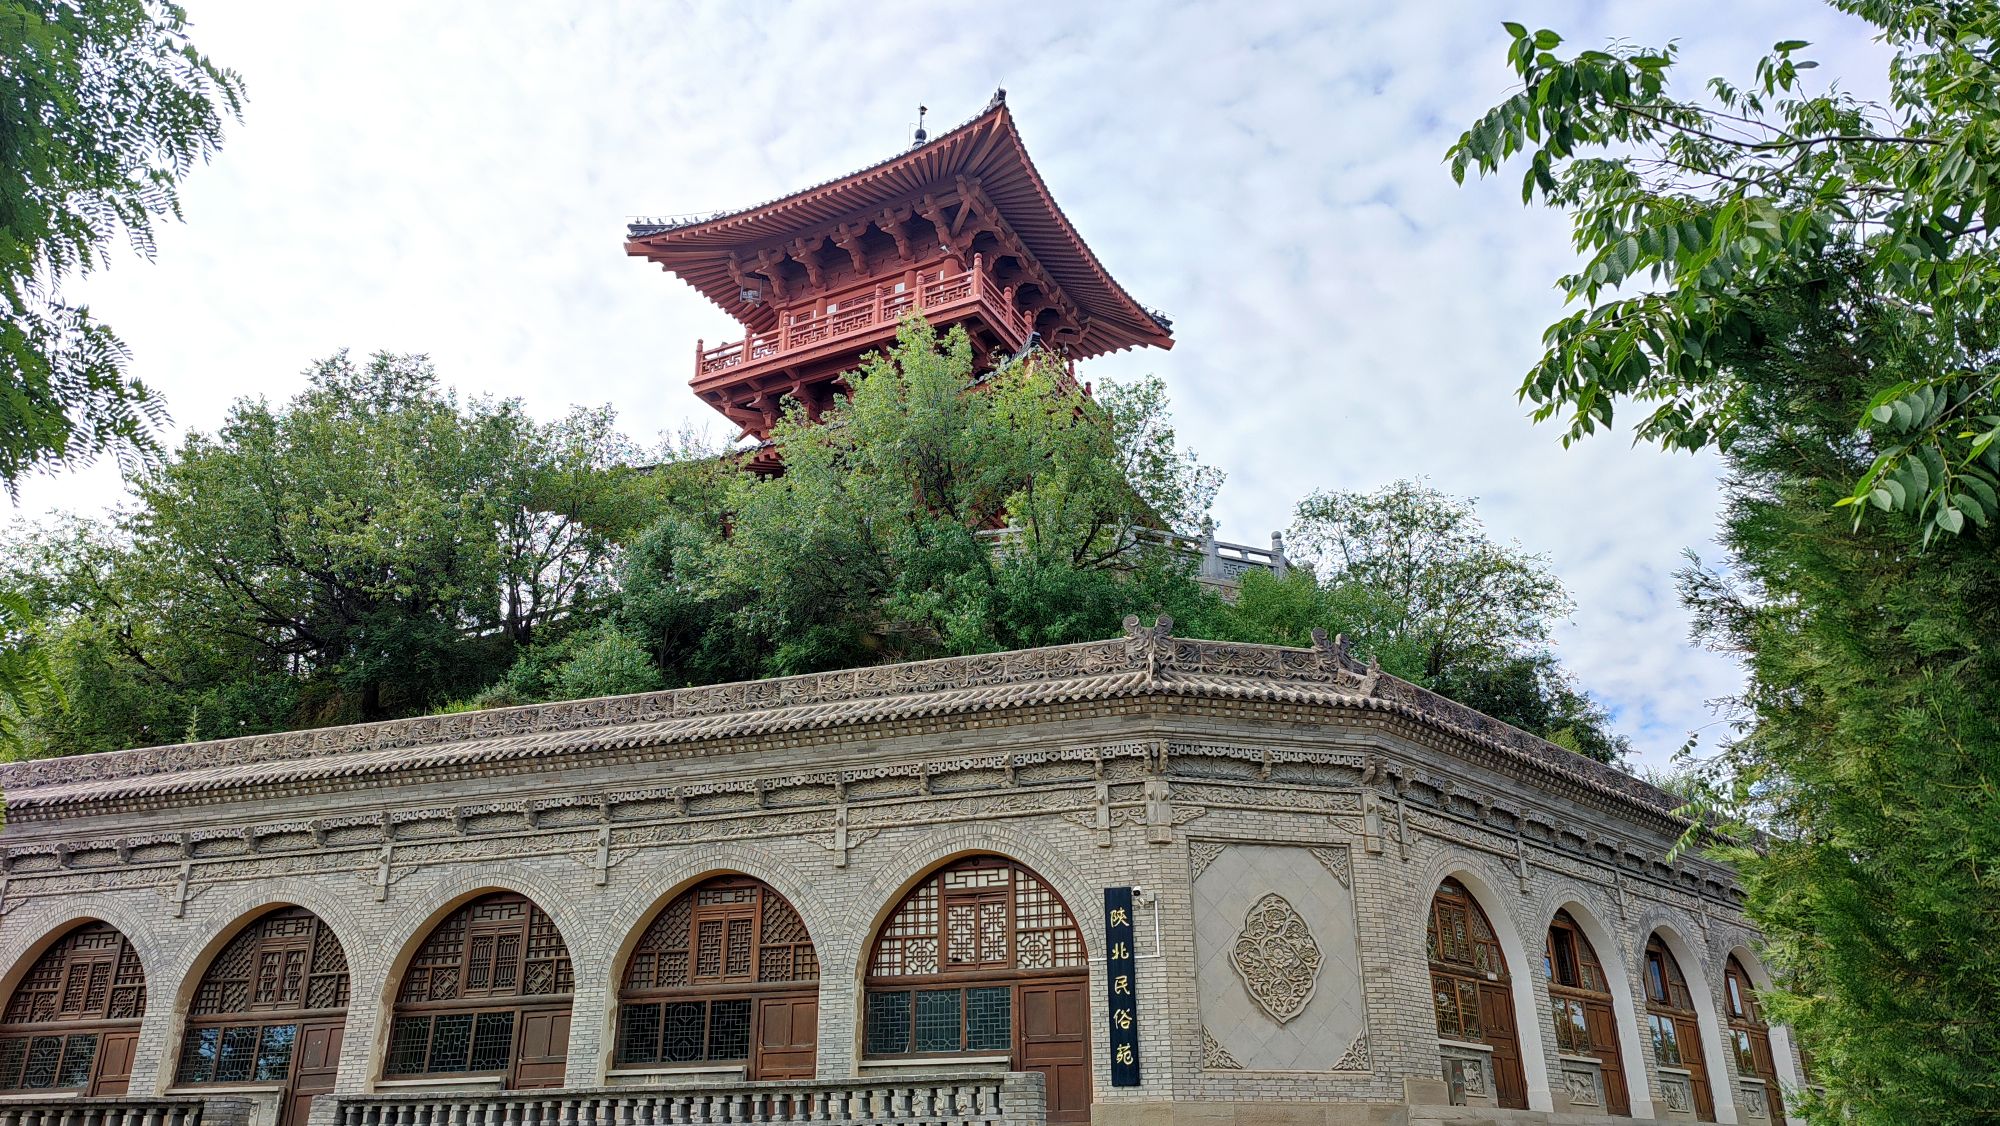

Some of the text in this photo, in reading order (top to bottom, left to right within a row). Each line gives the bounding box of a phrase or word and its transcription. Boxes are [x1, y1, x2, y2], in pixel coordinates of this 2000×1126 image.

[1110, 907, 1134, 1065] 陕北民俗苑
